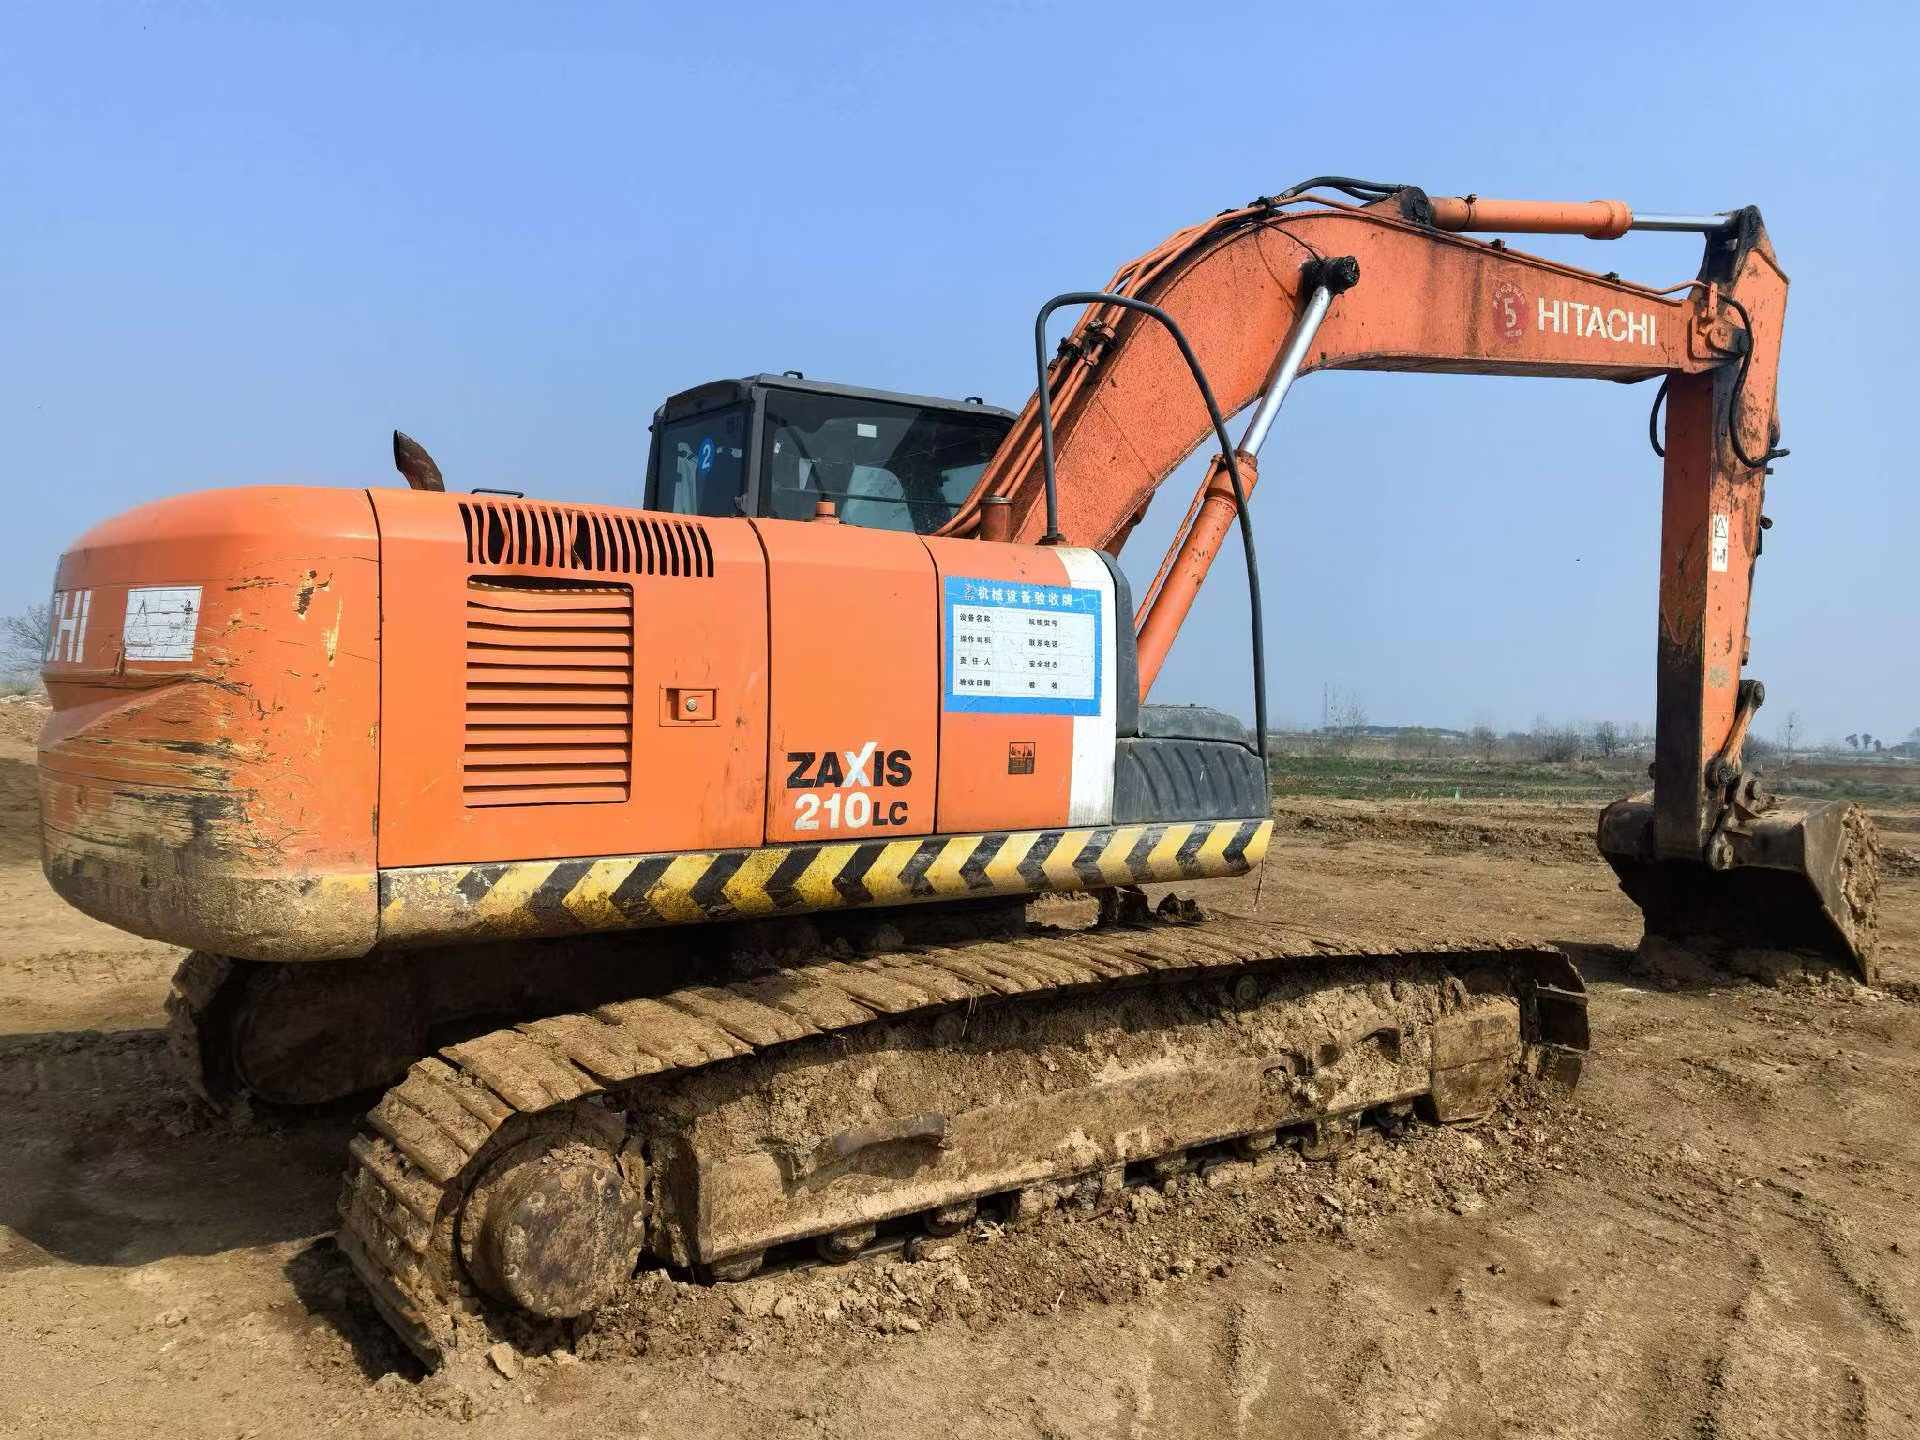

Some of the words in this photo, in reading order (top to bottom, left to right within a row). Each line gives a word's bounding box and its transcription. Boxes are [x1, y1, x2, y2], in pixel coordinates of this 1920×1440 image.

[1503, 297, 1517, 328] 5
[1538, 296, 1656, 346] HITACHI
[701, 444, 711, 469] 2
[978, 585, 1073, 607] 机械设备验收牌
[46, 590, 92, 663] HI
[787, 741, 913, 789] ZAXIS
